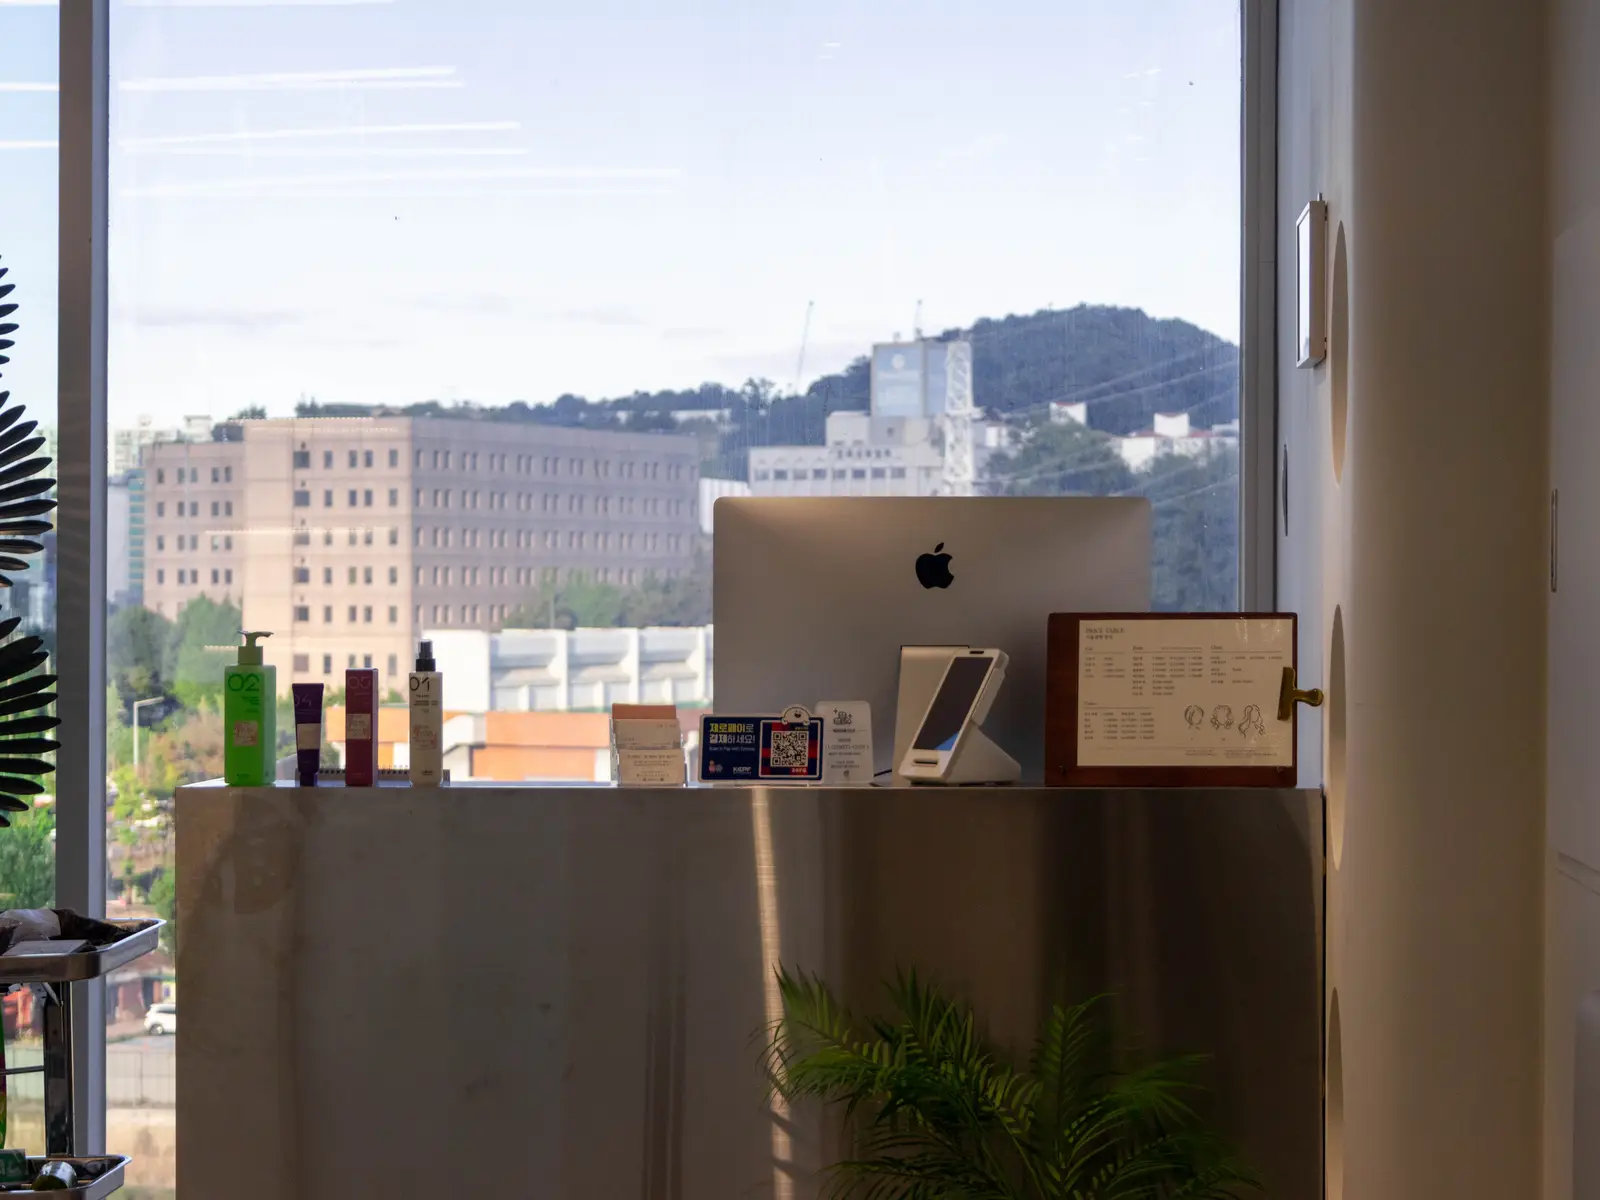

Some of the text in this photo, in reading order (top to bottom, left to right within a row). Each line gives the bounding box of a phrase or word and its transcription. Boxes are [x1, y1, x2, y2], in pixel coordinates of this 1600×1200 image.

[227, 673, 260, 692] 02
[409, 676, 430, 692] 01
[709, 723, 754, 733] 제로페이로
[709, 733, 756, 744] 결제하세요!
